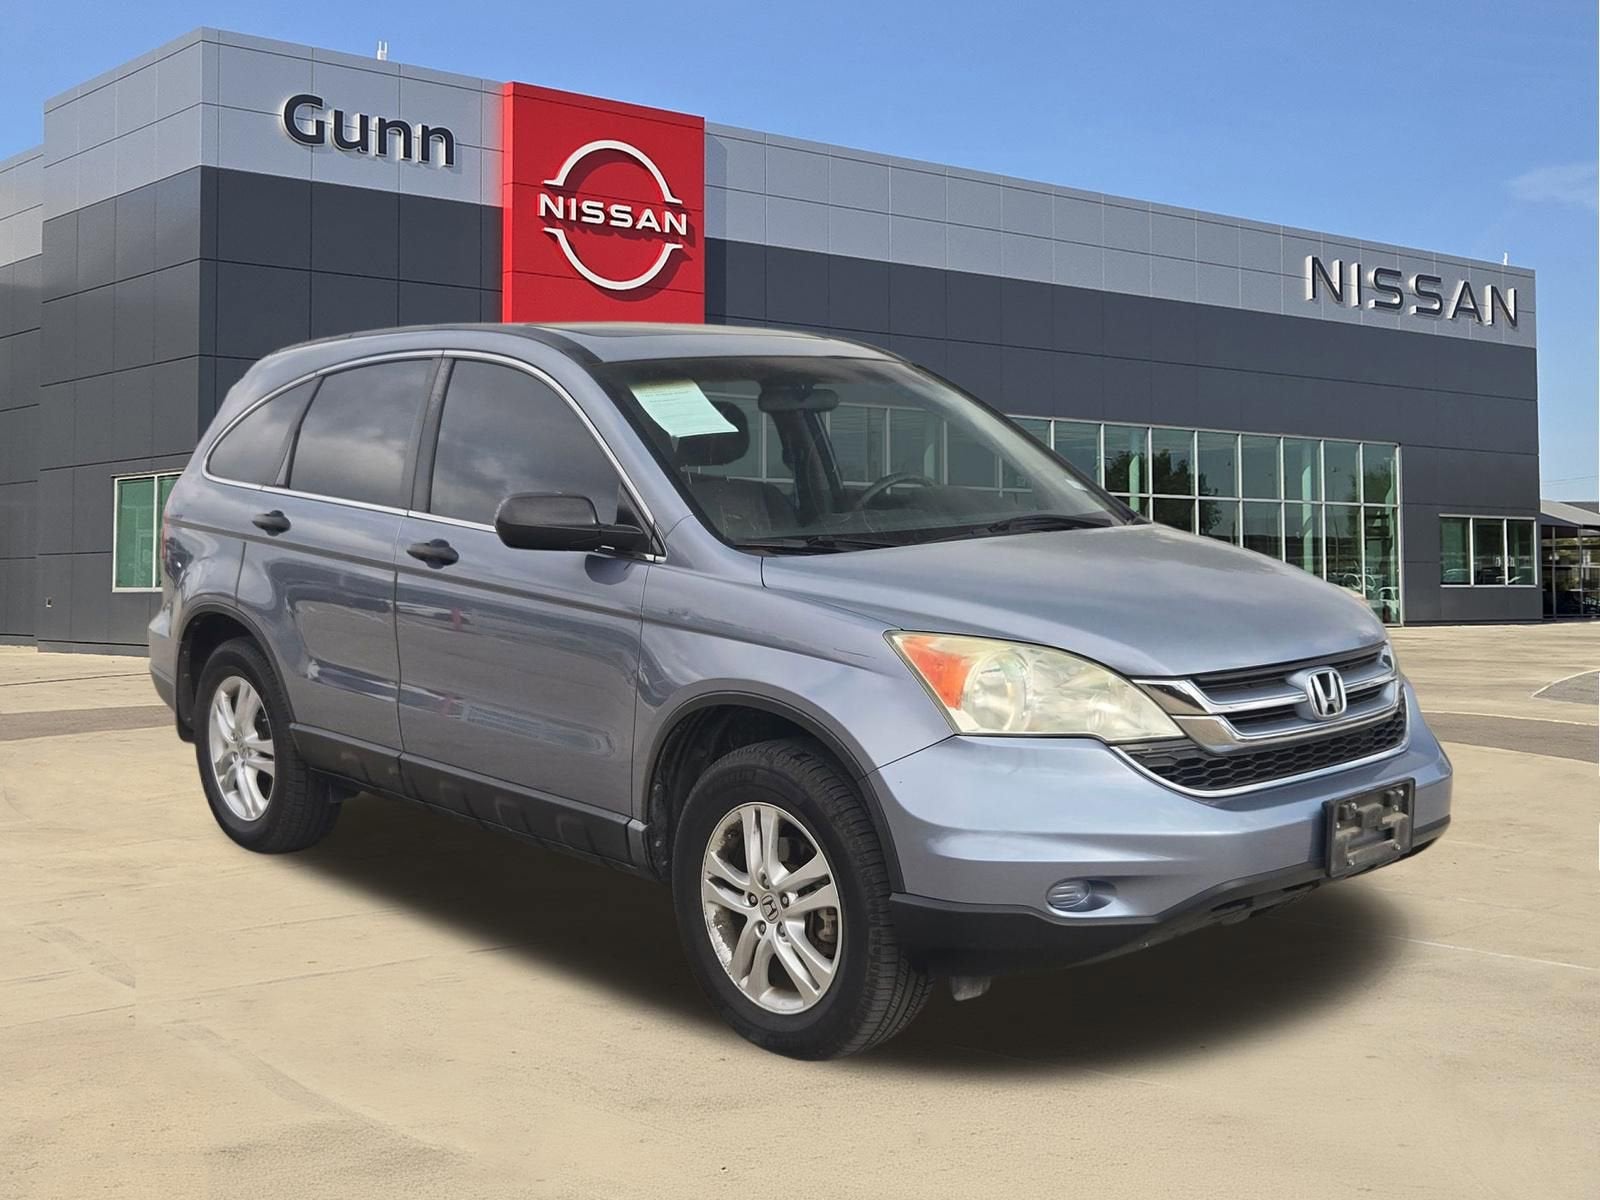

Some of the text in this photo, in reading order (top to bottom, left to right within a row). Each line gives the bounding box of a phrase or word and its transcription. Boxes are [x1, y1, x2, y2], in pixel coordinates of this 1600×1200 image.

[283, 93, 455, 167] Gunn
[538, 193, 687, 236] NISSAN
[1305, 255, 1518, 327] NISSAN
